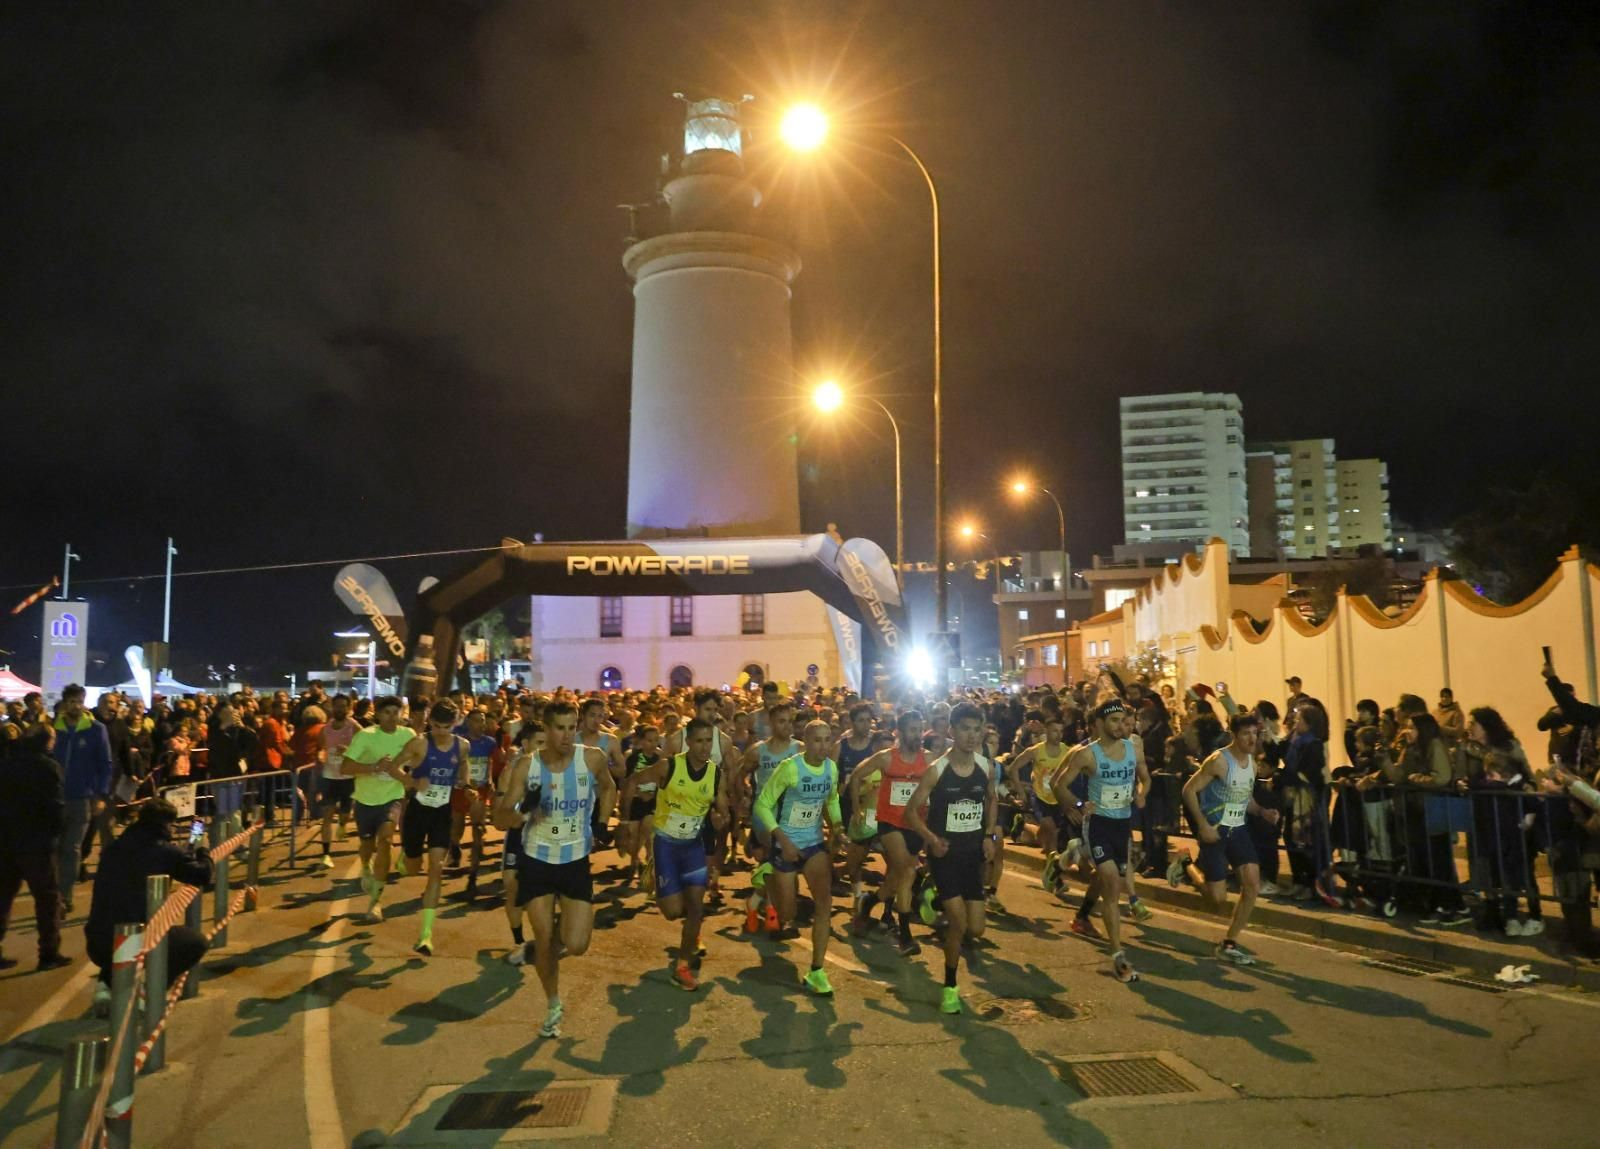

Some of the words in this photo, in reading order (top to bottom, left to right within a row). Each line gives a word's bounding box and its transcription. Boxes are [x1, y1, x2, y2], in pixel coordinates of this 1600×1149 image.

[566, 555, 753, 576] POWERADE
[1113, 792, 1120, 800] 2
[540, 796, 588, 815] álaga
[953, 812, 977, 820] 1047
[551, 826, 559, 835] 8
